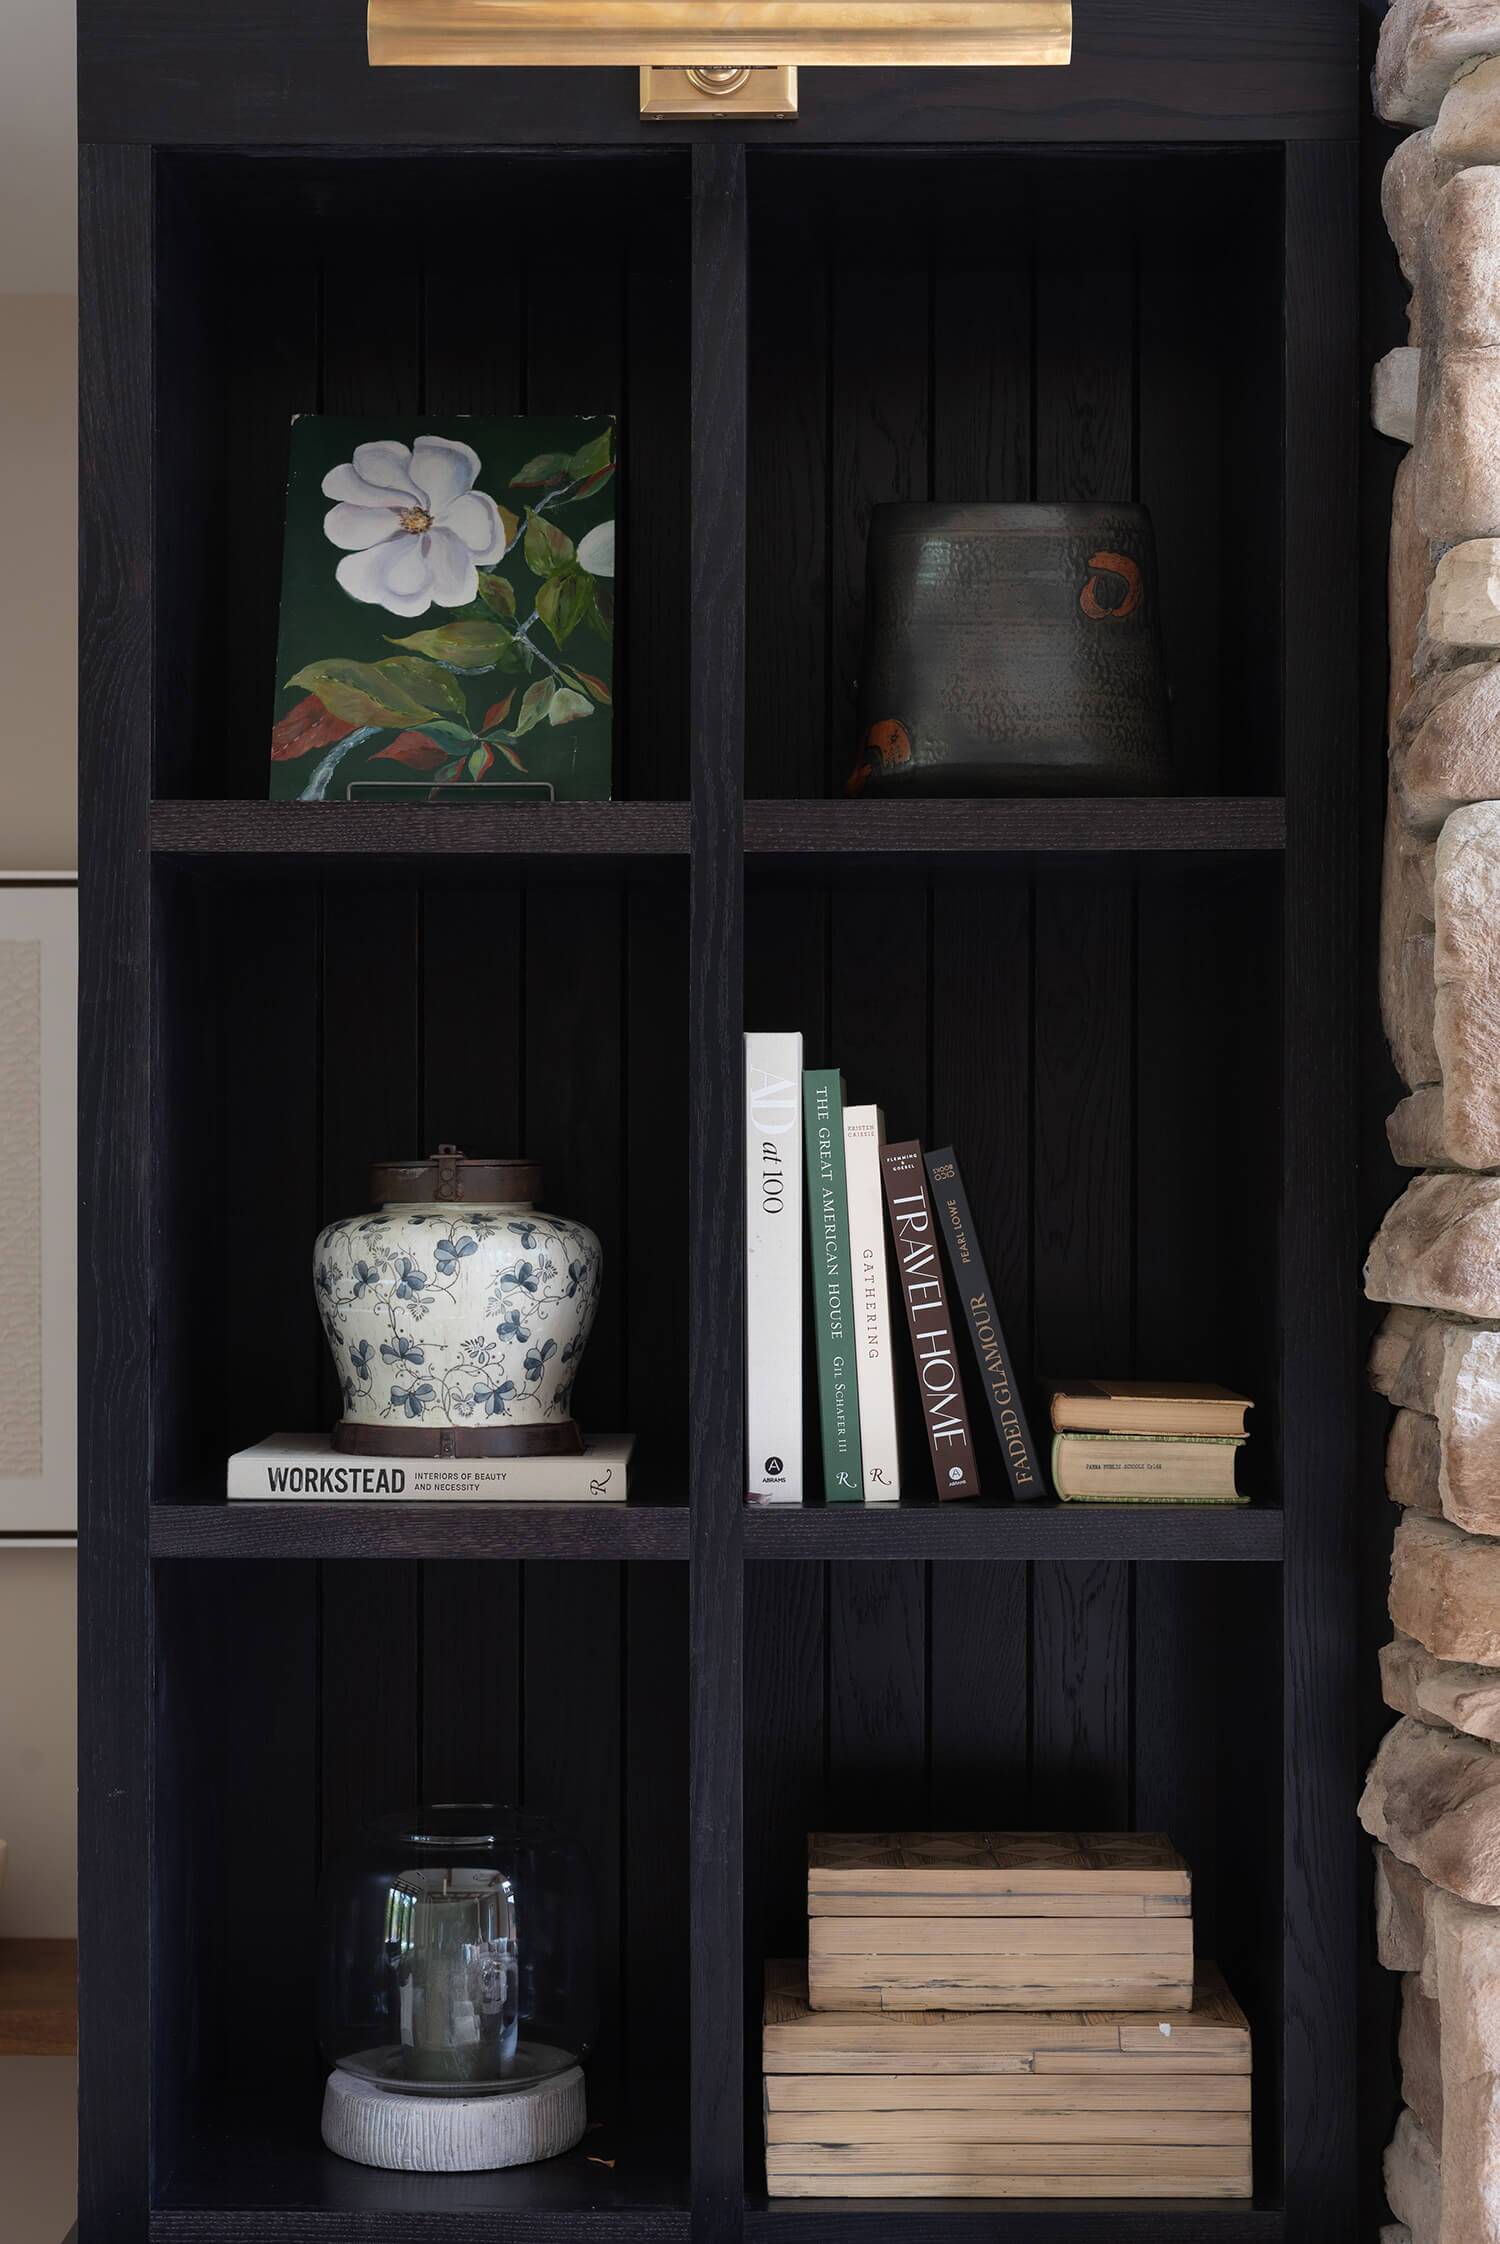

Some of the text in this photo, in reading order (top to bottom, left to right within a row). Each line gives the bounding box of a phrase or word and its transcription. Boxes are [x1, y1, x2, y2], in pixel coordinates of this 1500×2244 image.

[751, 1067, 797, 1214] AD at 100
[886, 1153, 918, 1163] FLEMMING
[816, 1086, 843, 1340] THE GREAT AMERICAN HOUSE
[947, 1199, 971, 1264] PEARL LOWE
[863, 1249, 880, 1359] GATHERING
[893, 1185, 967, 1451] TRAVEL HOME
[970, 1292, 1033, 1484] FADED GLAMOUR
[414, 1472, 507, 1480] INTERIORS OF BEAUTY
[838, 1439, 847, 1453] III
[268, 1467, 405, 1493] WORKSTEAD
[414, 1483, 480, 1491] AND NECESSITY
